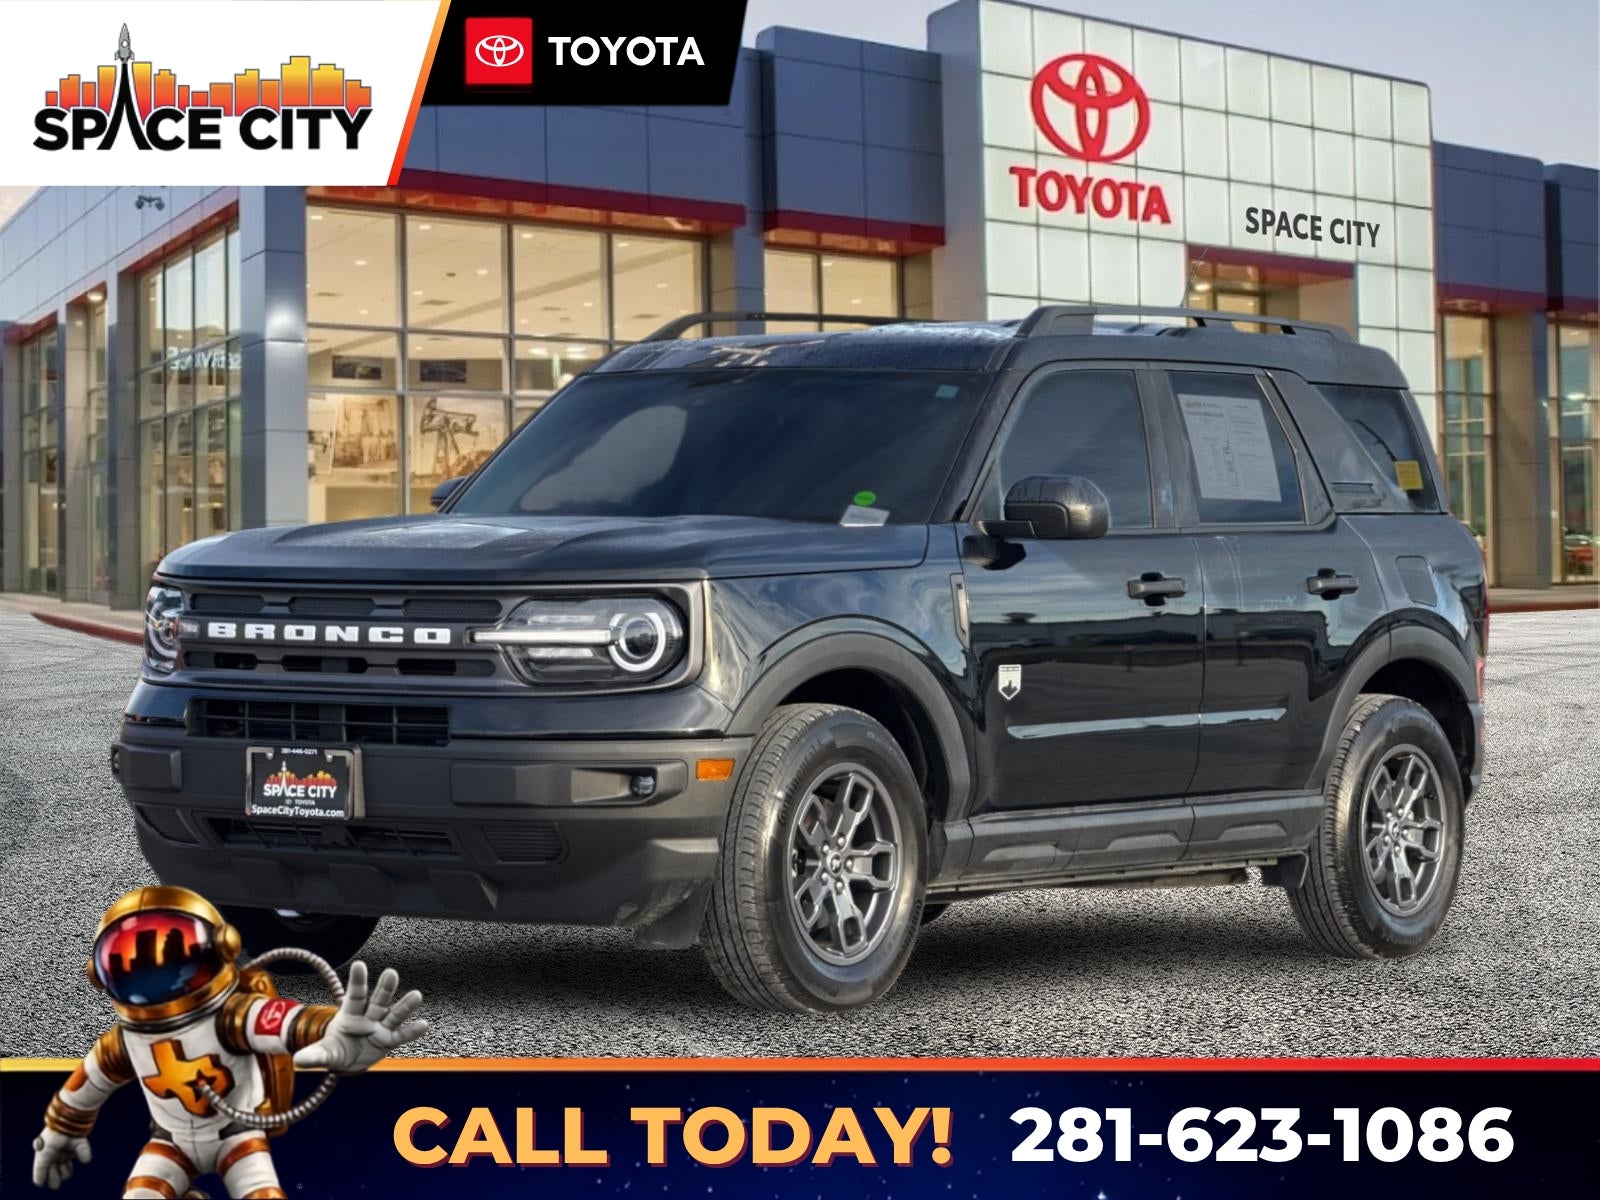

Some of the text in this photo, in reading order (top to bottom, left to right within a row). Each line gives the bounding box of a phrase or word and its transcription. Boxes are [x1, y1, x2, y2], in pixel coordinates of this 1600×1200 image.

[1009, 166, 1171, 224] TOYOTA
[1245, 207, 1381, 248] SPACE CITY
[207, 621, 452, 645] BRONCO
[263, 782, 338, 798] SPACE CITY
[251, 804, 345, 818] SpaceCityToyota.com
